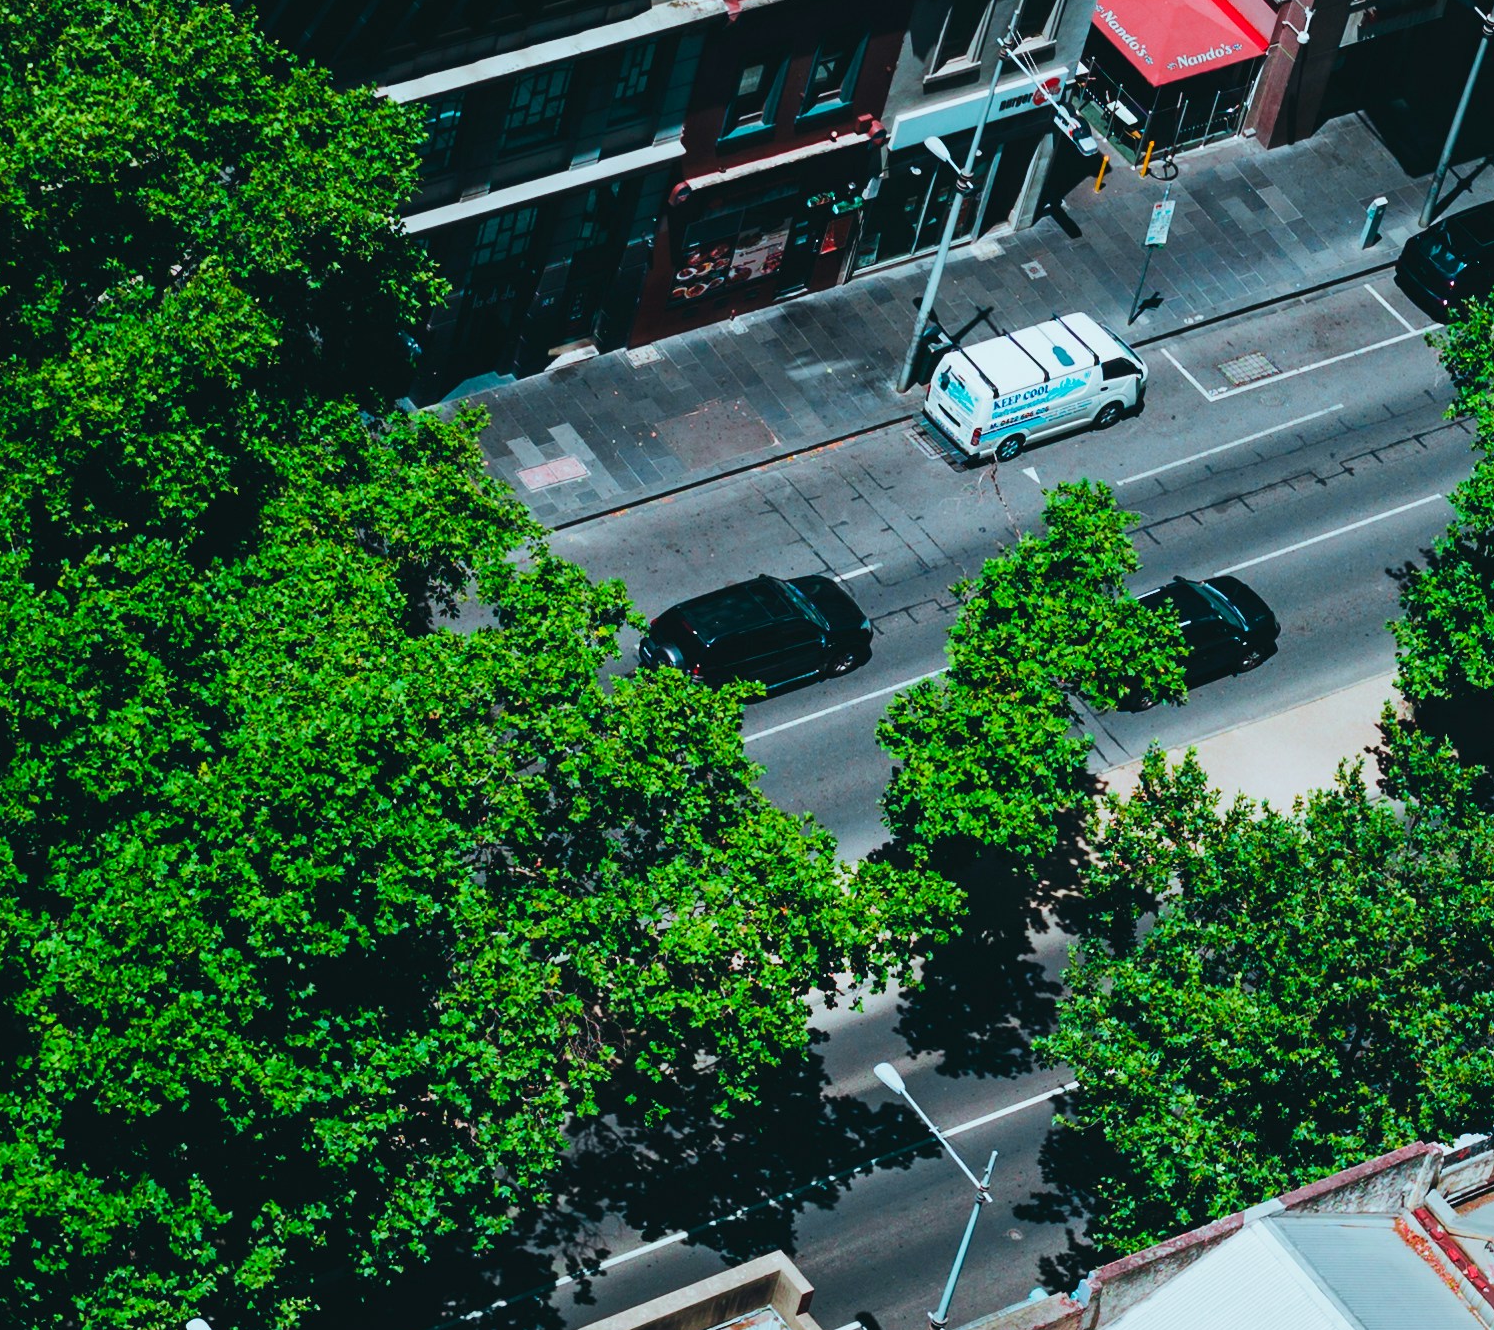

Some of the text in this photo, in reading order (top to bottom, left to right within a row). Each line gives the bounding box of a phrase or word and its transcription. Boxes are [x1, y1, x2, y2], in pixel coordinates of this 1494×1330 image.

[1100, 9, 1147, 58] Nando's
[1176, 43, 1233, 69] Nando's
[993, 393, 1022, 411] KEEP
[1023, 384, 1049, 401] COOL
